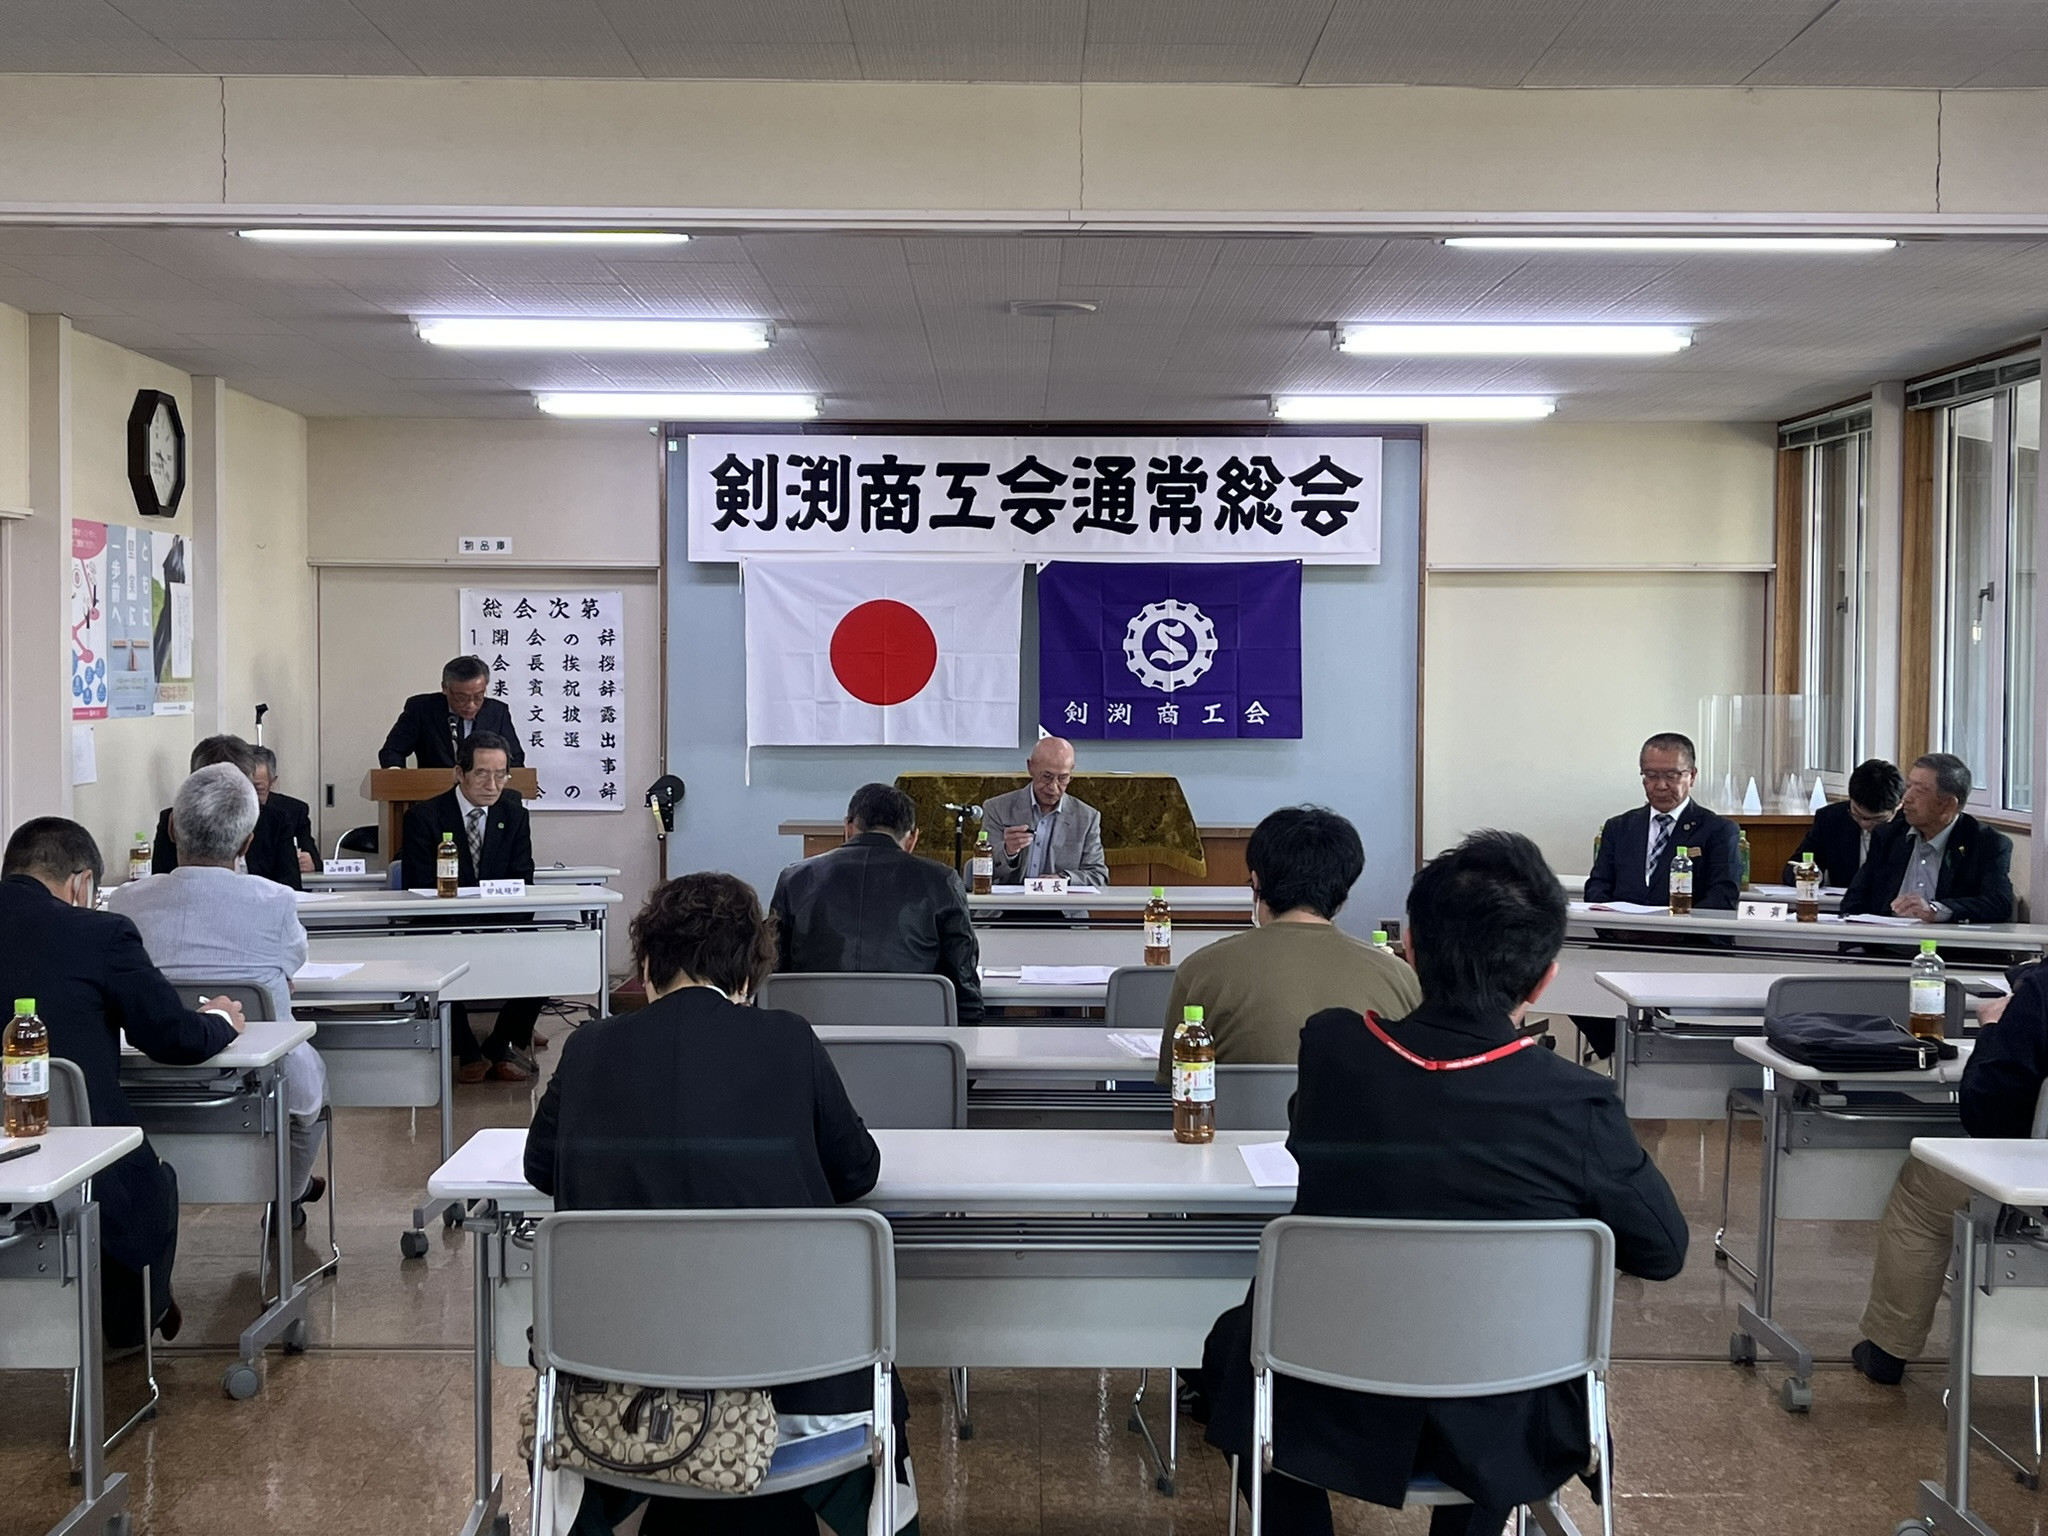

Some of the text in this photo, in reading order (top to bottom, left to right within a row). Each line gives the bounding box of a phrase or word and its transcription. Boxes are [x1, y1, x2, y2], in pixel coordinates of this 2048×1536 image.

[709, 453, 1364, 537] 剣渕商工会通常総会
[482, 597, 600, 620] 総会次第
[1063, 701, 1270, 726] 剣渕商工会
[1030, 880, 1063, 893] 議長
